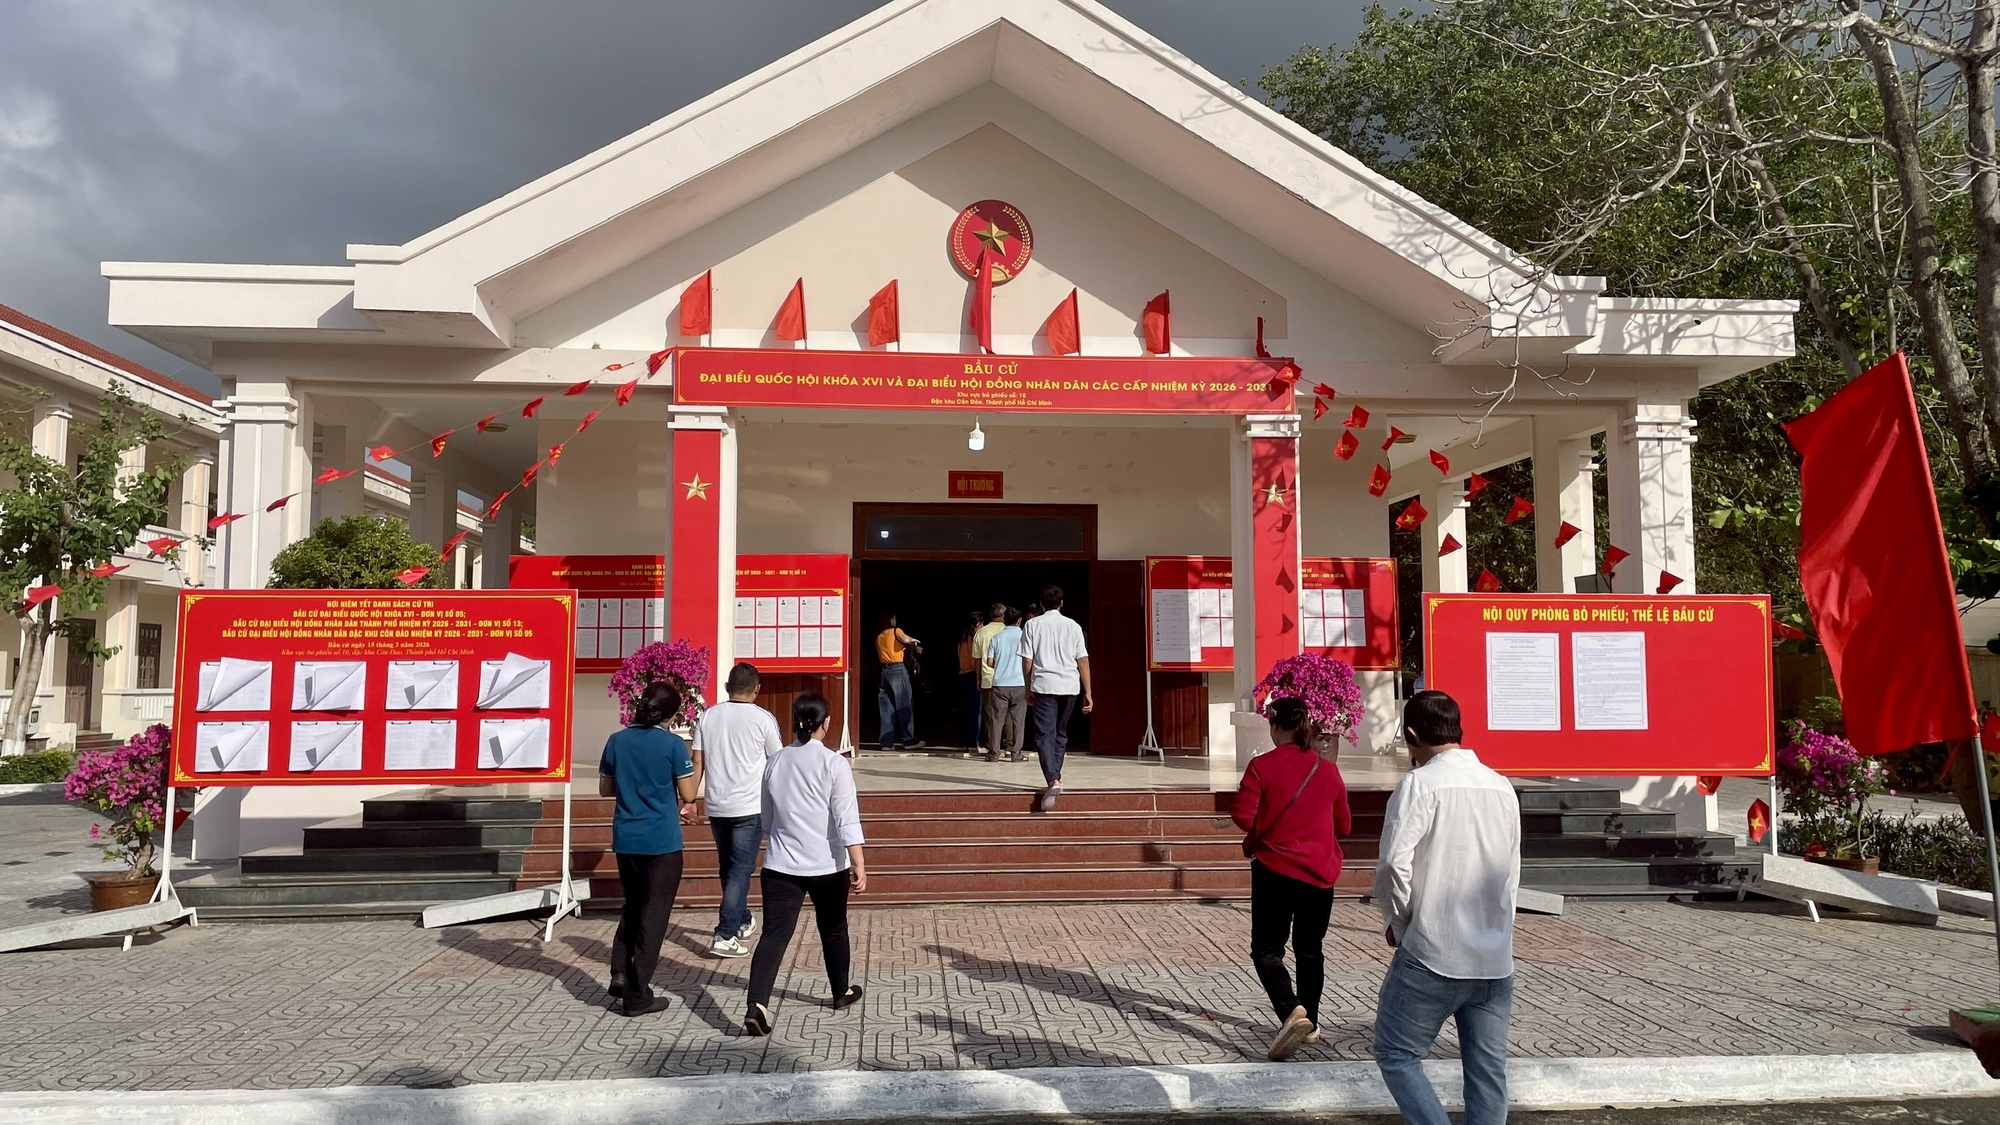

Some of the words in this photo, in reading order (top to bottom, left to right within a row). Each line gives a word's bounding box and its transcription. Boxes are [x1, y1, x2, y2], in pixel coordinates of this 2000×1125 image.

[964, 359, 993, 374] BẦU
[998, 361, 1018, 374] CỬ
[700, 374, 721, 384] ĐẠI
[726, 371, 750, 383] BIỂU
[755, 372, 792, 384] QUỐC
[797, 374, 818, 386] HỘI
[824, 375, 858, 385] KHÓA
[863, 377, 882, 386] XVI
[887, 376, 903, 386] VÀ
[907, 379, 928, 389] ĐẠI
[932, 375, 956, 387] BIỂU
[961, 378, 982, 390] HỘI
[986, 376, 1022, 388] ĐỒNG
[1027, 379, 1059, 389] NHÂN
[1064, 380, 1088, 389] DÂN
[1092, 380, 1118, 390] CÁC
[1122, 380, 1148, 390] CẤP
[1151, 381, 1187, 393] NHIỆM
[1191, 381, 1205, 391] KỲ
[1210, 383, 1236, 391] 2026
[991, 391, 1007, 400] phiếu
[957, 477, 967, 494] HỘI
[341, 599, 357, 607] NIÊM
[360, 599, 371, 607] YẾT
[393, 599, 410, 607] SÁCH
[412, 599, 421, 607] CỬ
[293, 609, 306, 617] BẦU
[309, 609, 318, 617] CỬ
[320, 611, 331, 619] ĐẠI
[333, 609, 348, 617] BIỂU
[350, 609, 368, 617] QUỐC
[371, 609, 382, 619] HỘI
[384, 609, 401, 617] KHÓA
[437, 611, 443, 619] VỊ
[445, 609, 453, 617] SỐ
[1483, 606, 1502, 623] NỘI
[1506, 608, 1527, 621] QUY
[1532, 606, 1569, 621] PHÒNG
[1573, 606, 1588, 621] BỎ
[1592, 605, 1629, 623] PHIẾU;
[1633, 605, 1653, 621] THỂ
[1657, 607, 1669, 624] LỆ
[1673, 606, 1694, 622] BẦU
[1698, 606, 1714, 622] CỬ
[233, 619, 246, 627] BẦU
[249, 619, 258, 627] CỬ
[260, 621, 271, 629] ĐẠI
[273, 619, 288, 627] BIỂU
[291, 619, 302, 629] HỘI
[304, 619, 322, 627] ĐỒNG
[324, 619, 342, 627] NHÂN
[345, 619, 358, 627] DÂN
[360, 619, 381, 627] THÀNH
[384, 619, 397, 627] PHỐ
[399, 619, 420, 629] NHIỆM
[423, 619, 430, 627] KỲ
[494, 621, 500, 629] VỊ
[503, 619, 511, 627] SỐ
[223, 629, 236, 637] BẦU
[238, 629, 247, 637] CỬ
[249, 631, 260, 639] ĐẠI
[262, 629, 278, 637] BIỂU
[280, 629, 291, 639] HỘI
[293, 629, 311, 637] ĐỒNG
[314, 629, 332, 637] NHÂN
[334, 629, 347, 637] DÂN
[349, 631, 362, 639] ĐẶC
[380, 629, 393, 637] CÔN
[396, 629, 409, 637] ĐẢO
[411, 629, 432, 639] NHIỆM
[434, 629, 442, 637] KỲ
[506, 631, 512, 639] VỊ
[514, 629, 522, 637] SỐ
